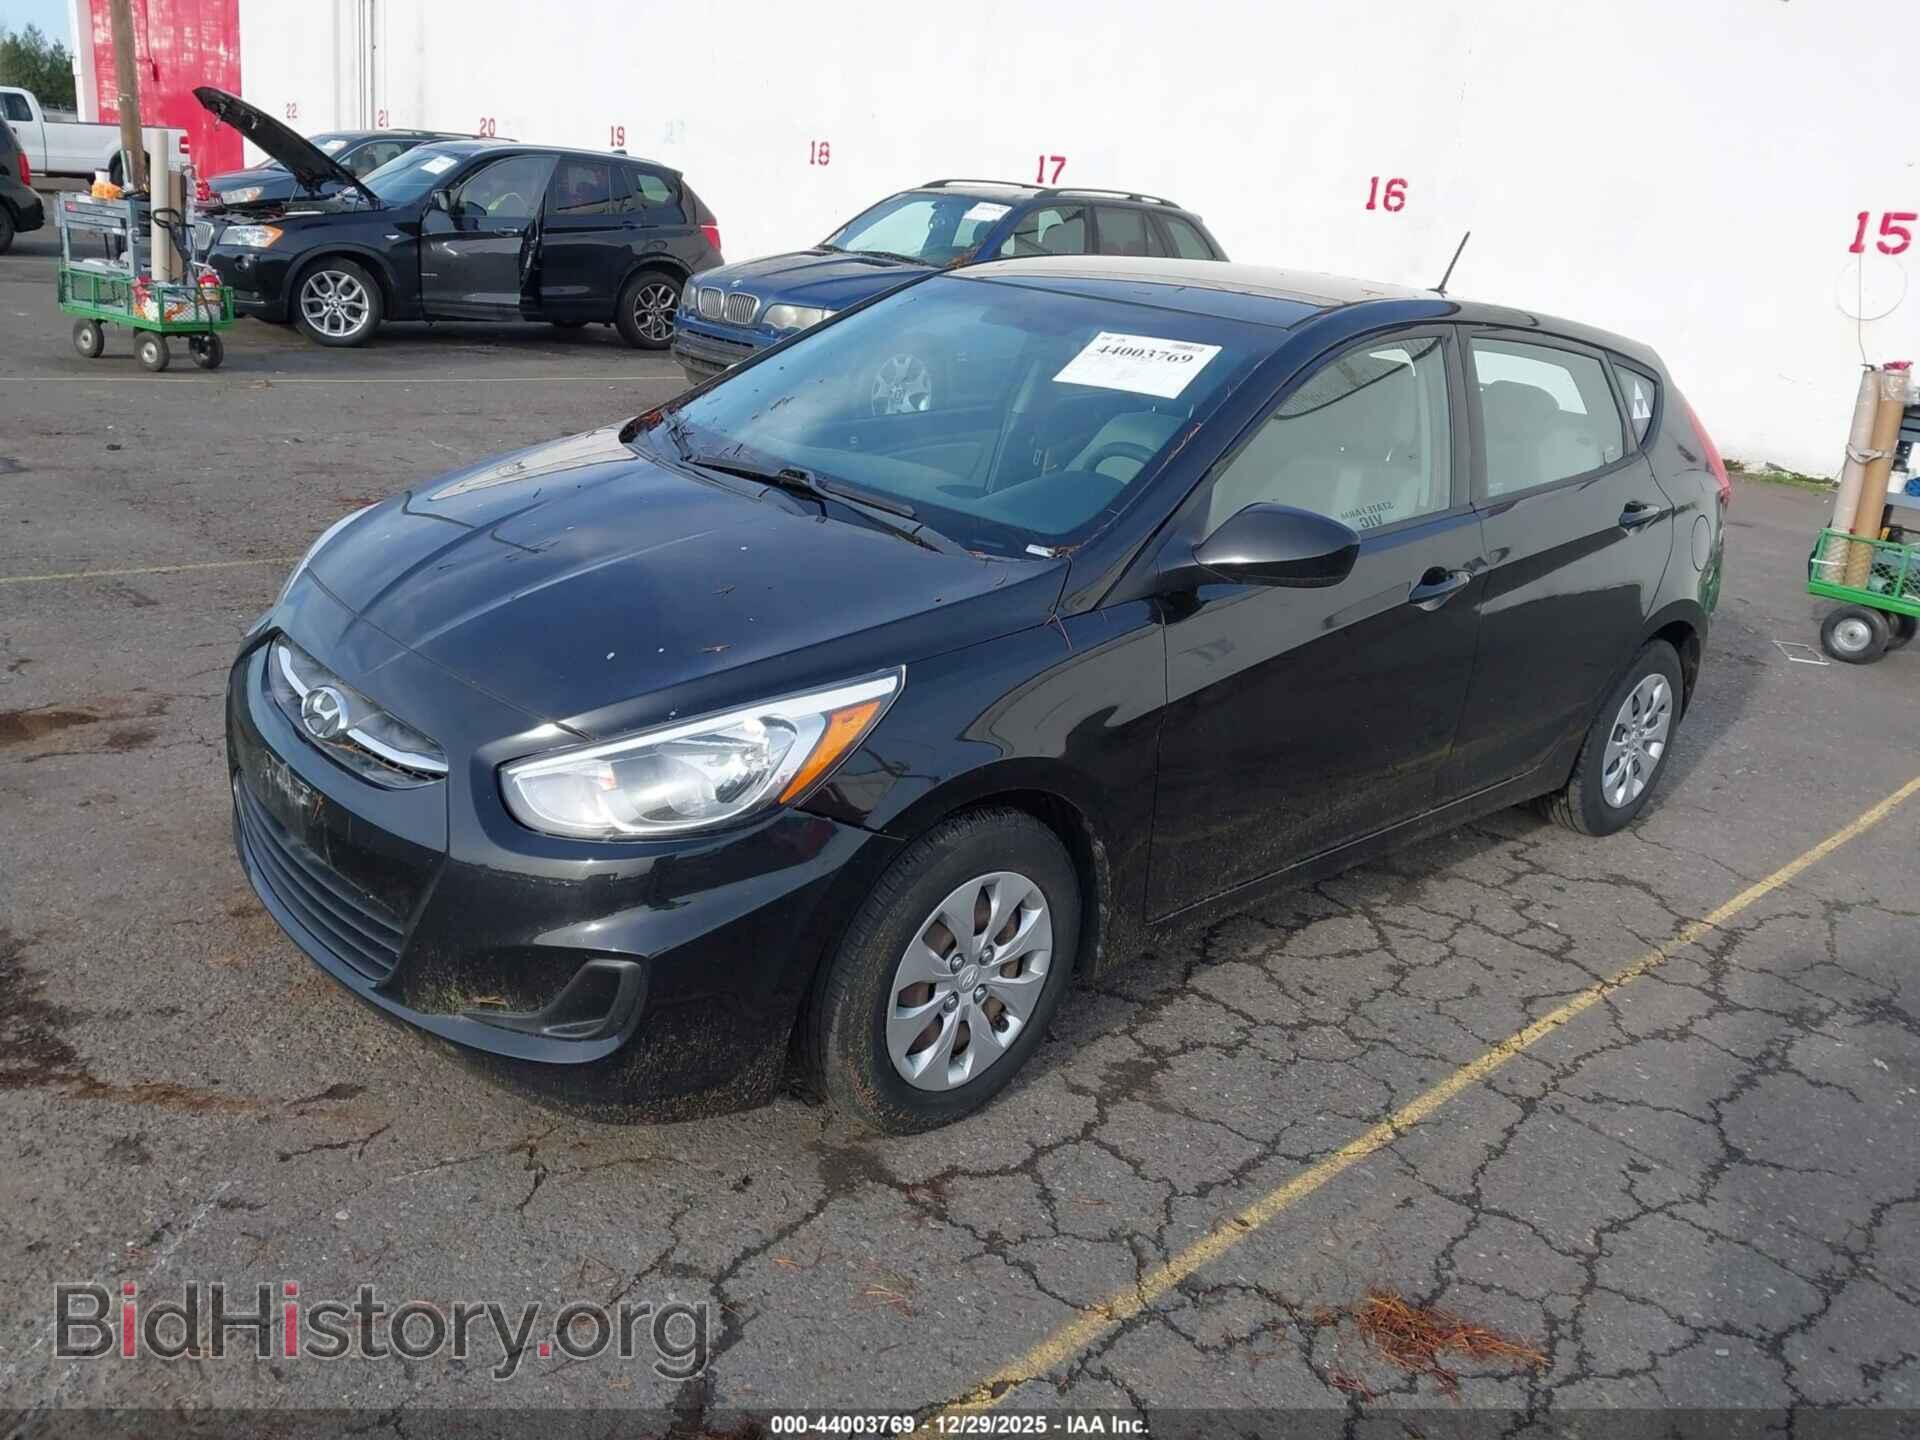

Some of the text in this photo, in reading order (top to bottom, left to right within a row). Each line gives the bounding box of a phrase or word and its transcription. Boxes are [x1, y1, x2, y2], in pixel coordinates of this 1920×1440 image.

[286, 102, 298, 119] 22
[378, 109, 390, 128] 21
[479, 117, 496, 137] 20
[610, 126, 625, 147] 19
[809, 140, 831, 167] 18
[1036, 154, 1066, 185] 17
[1365, 175, 1409, 213] 16
[1848, 210, 1919, 255] 15
[1097, 344, 1195, 364] 44003769
